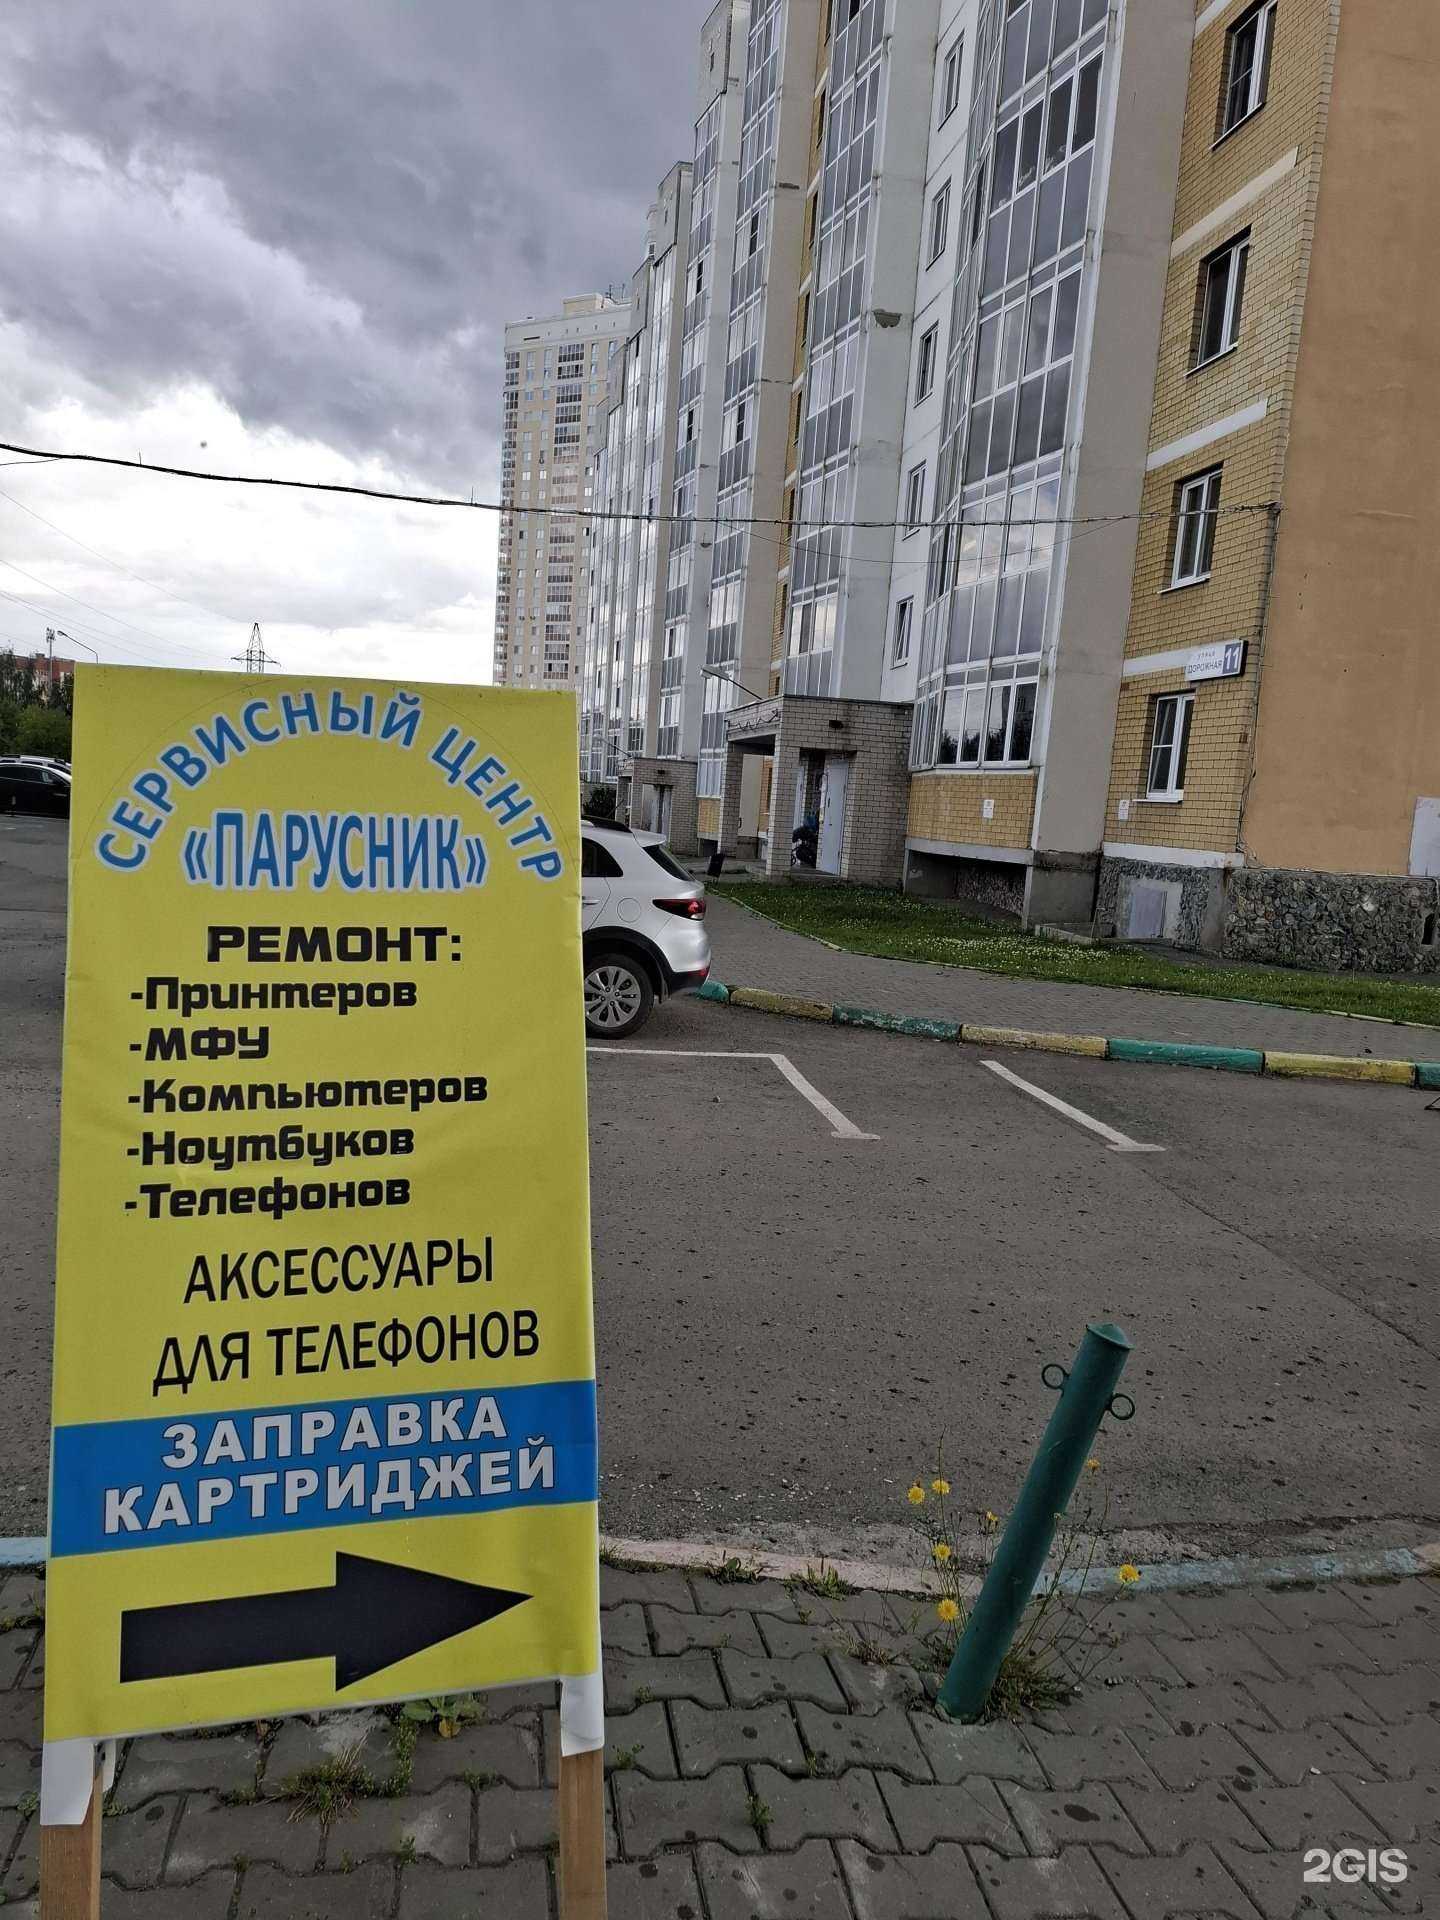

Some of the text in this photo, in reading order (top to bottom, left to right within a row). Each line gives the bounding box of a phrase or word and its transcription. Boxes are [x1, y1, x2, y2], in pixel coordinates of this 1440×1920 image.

[1225, 647, 1240, 670] 11
[99, 691, 562, 879] СЕРВИСНЫЙ ЦЕНТР
[184, 813, 487, 889] «ПАРУСНИК»
[207, 926, 462, 962] РЕМОНТ:
[131, 977, 417, 1016] -Принтеров
[130, 1027, 269, 1061] -МФУ
[129, 1076, 487, 1113] -Компьютеров
[127, 1125, 413, 1170] -Ноутбуков
[125, 1177, 411, 1219] -Телефонов
[184, 1237, 492, 1303] АКСЕССУАРЫ
[153, 1310, 540, 1396] ДЛЯ ТЕЛЕФОНОВ
[163, 1396, 506, 1468] ЗАПРАВКА
[105, 1437, 554, 1534] КАРТРИДЖЕЙ
